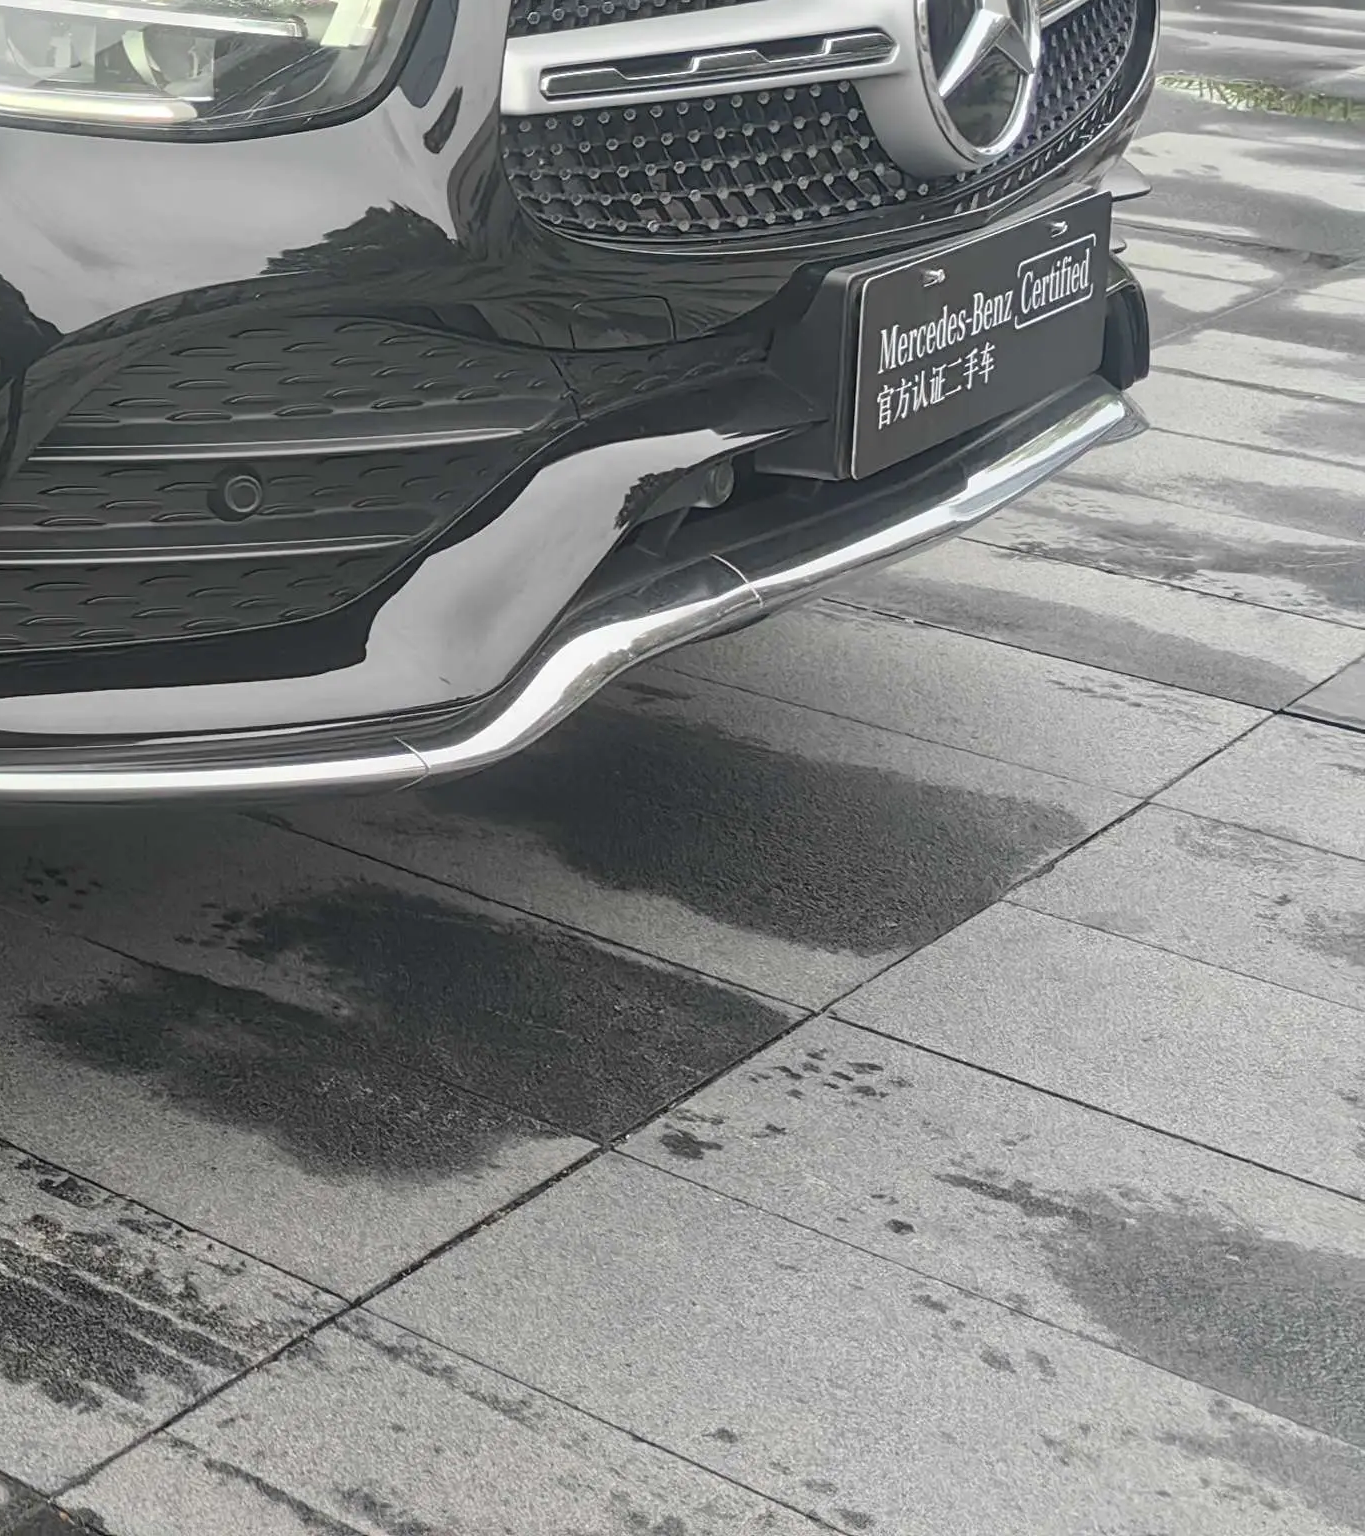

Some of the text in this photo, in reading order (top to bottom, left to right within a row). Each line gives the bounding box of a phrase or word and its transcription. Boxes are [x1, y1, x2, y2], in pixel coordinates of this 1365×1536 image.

[876, 248, 1091, 375] Mercedes-Benz Certified
[876, 341, 996, 430] 官方认证二手车
